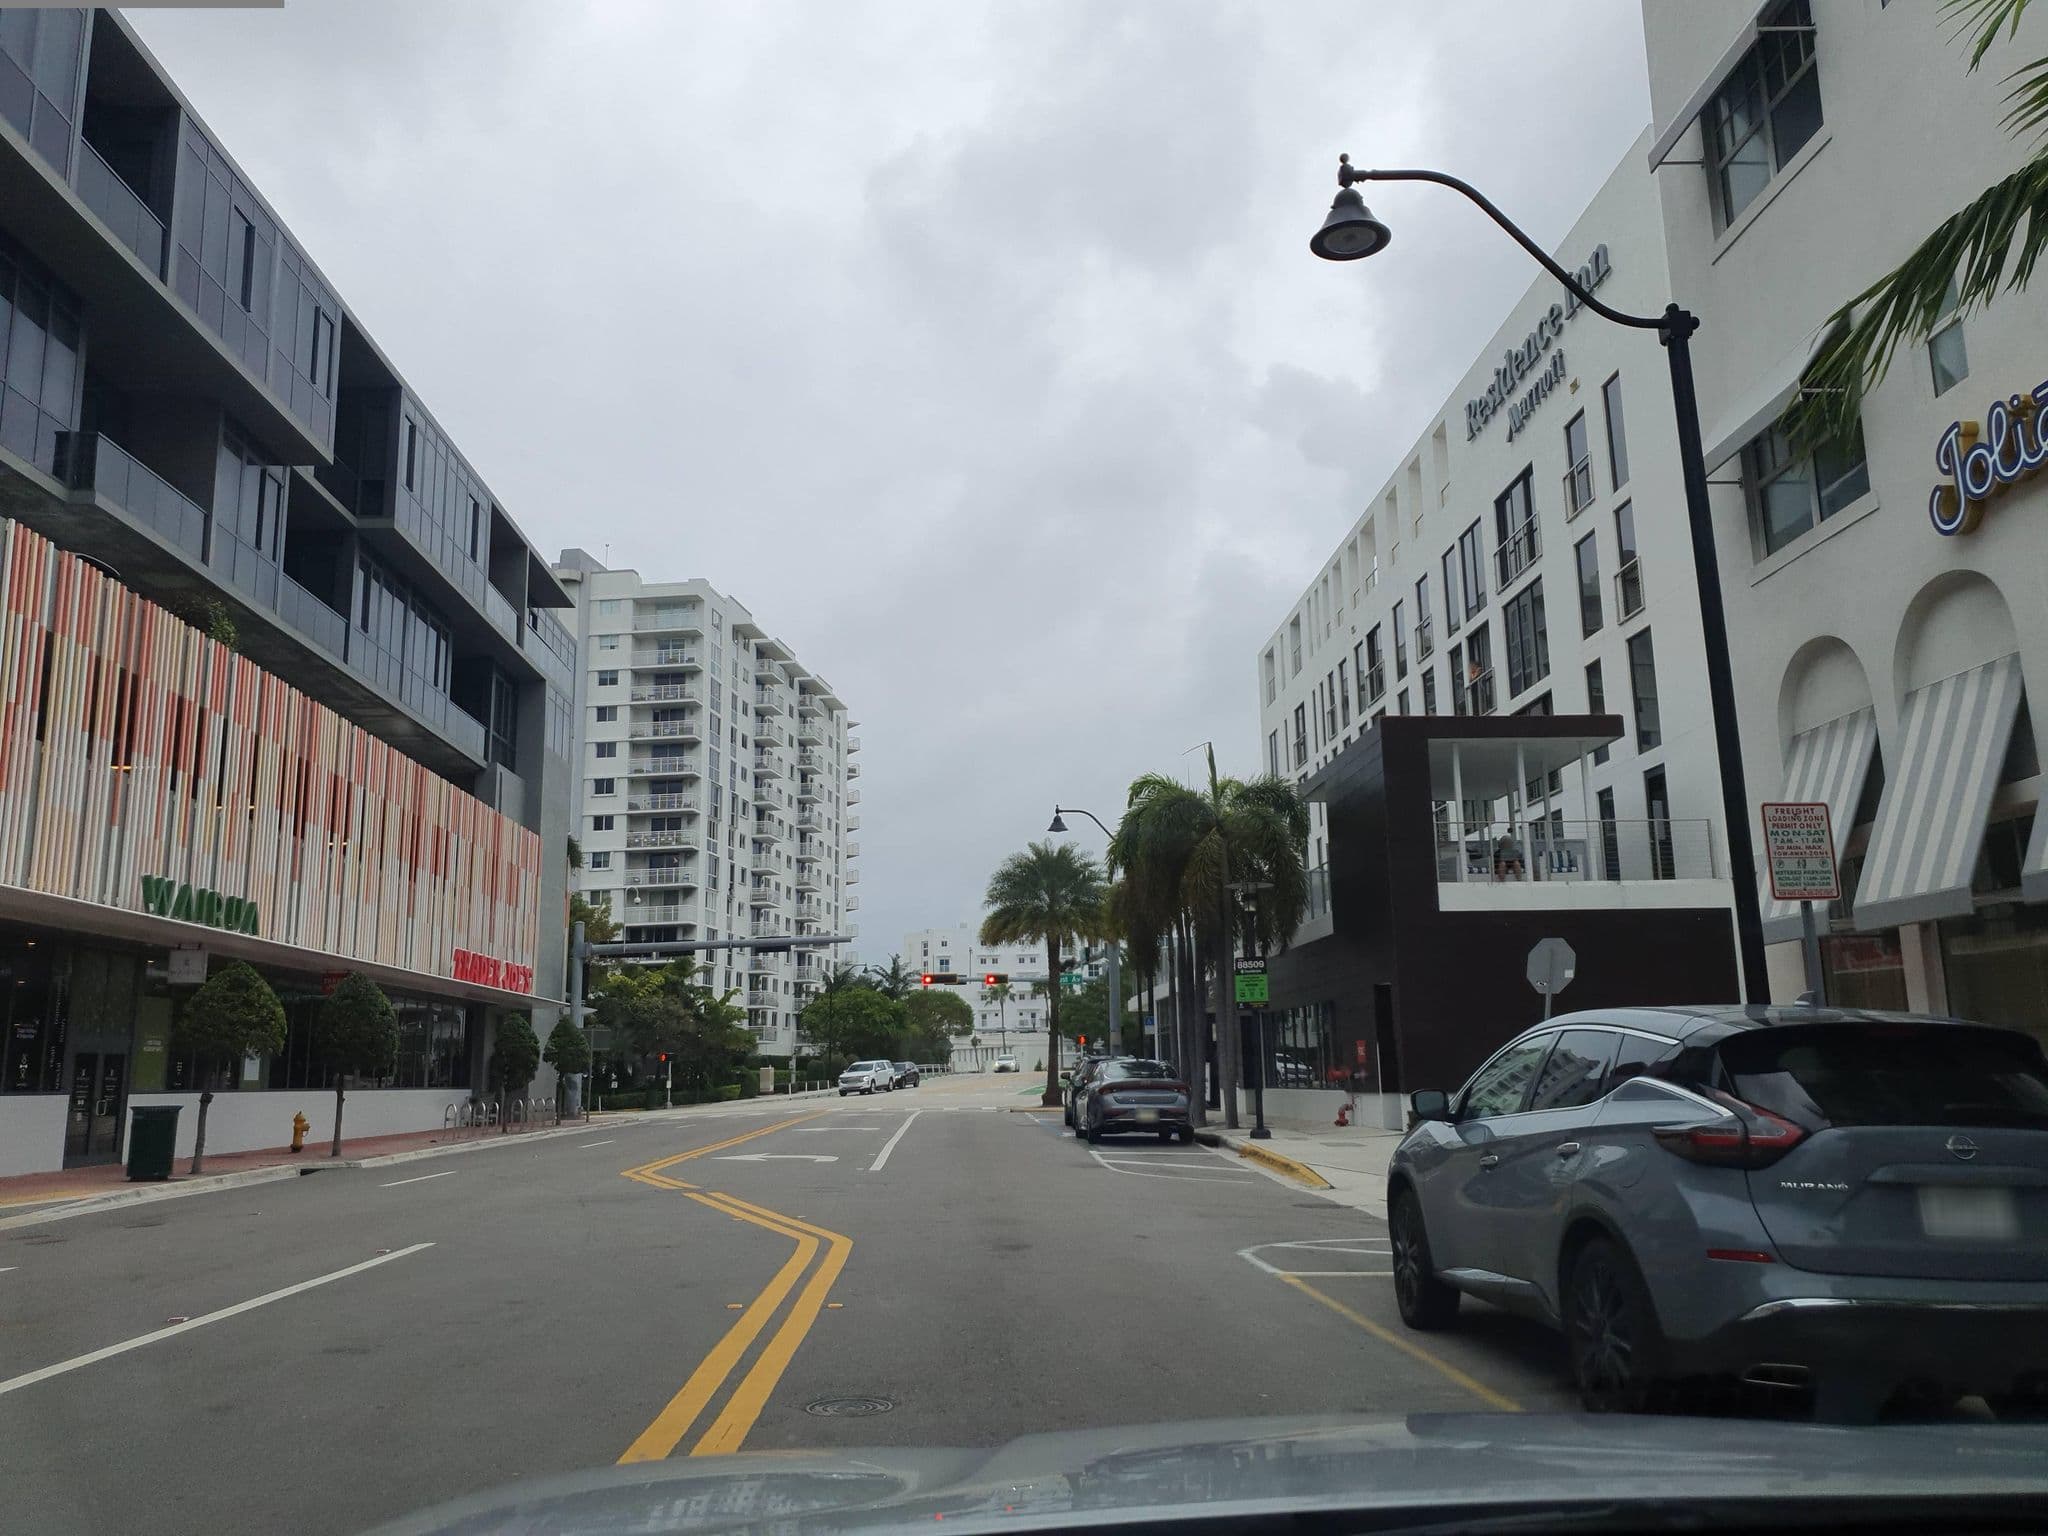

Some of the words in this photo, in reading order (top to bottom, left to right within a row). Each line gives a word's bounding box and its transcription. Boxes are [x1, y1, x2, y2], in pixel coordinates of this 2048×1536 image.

[1464, 303, 1564, 442] Residence
[1564, 243, 1612, 320] Inn
[1507, 348, 1566, 443] Marriott
[1775, 807, 1815, 815] FREIGHT
[452, 947, 501, 989] TRADER
[1780, 1181, 1849, 1191] MURANO
